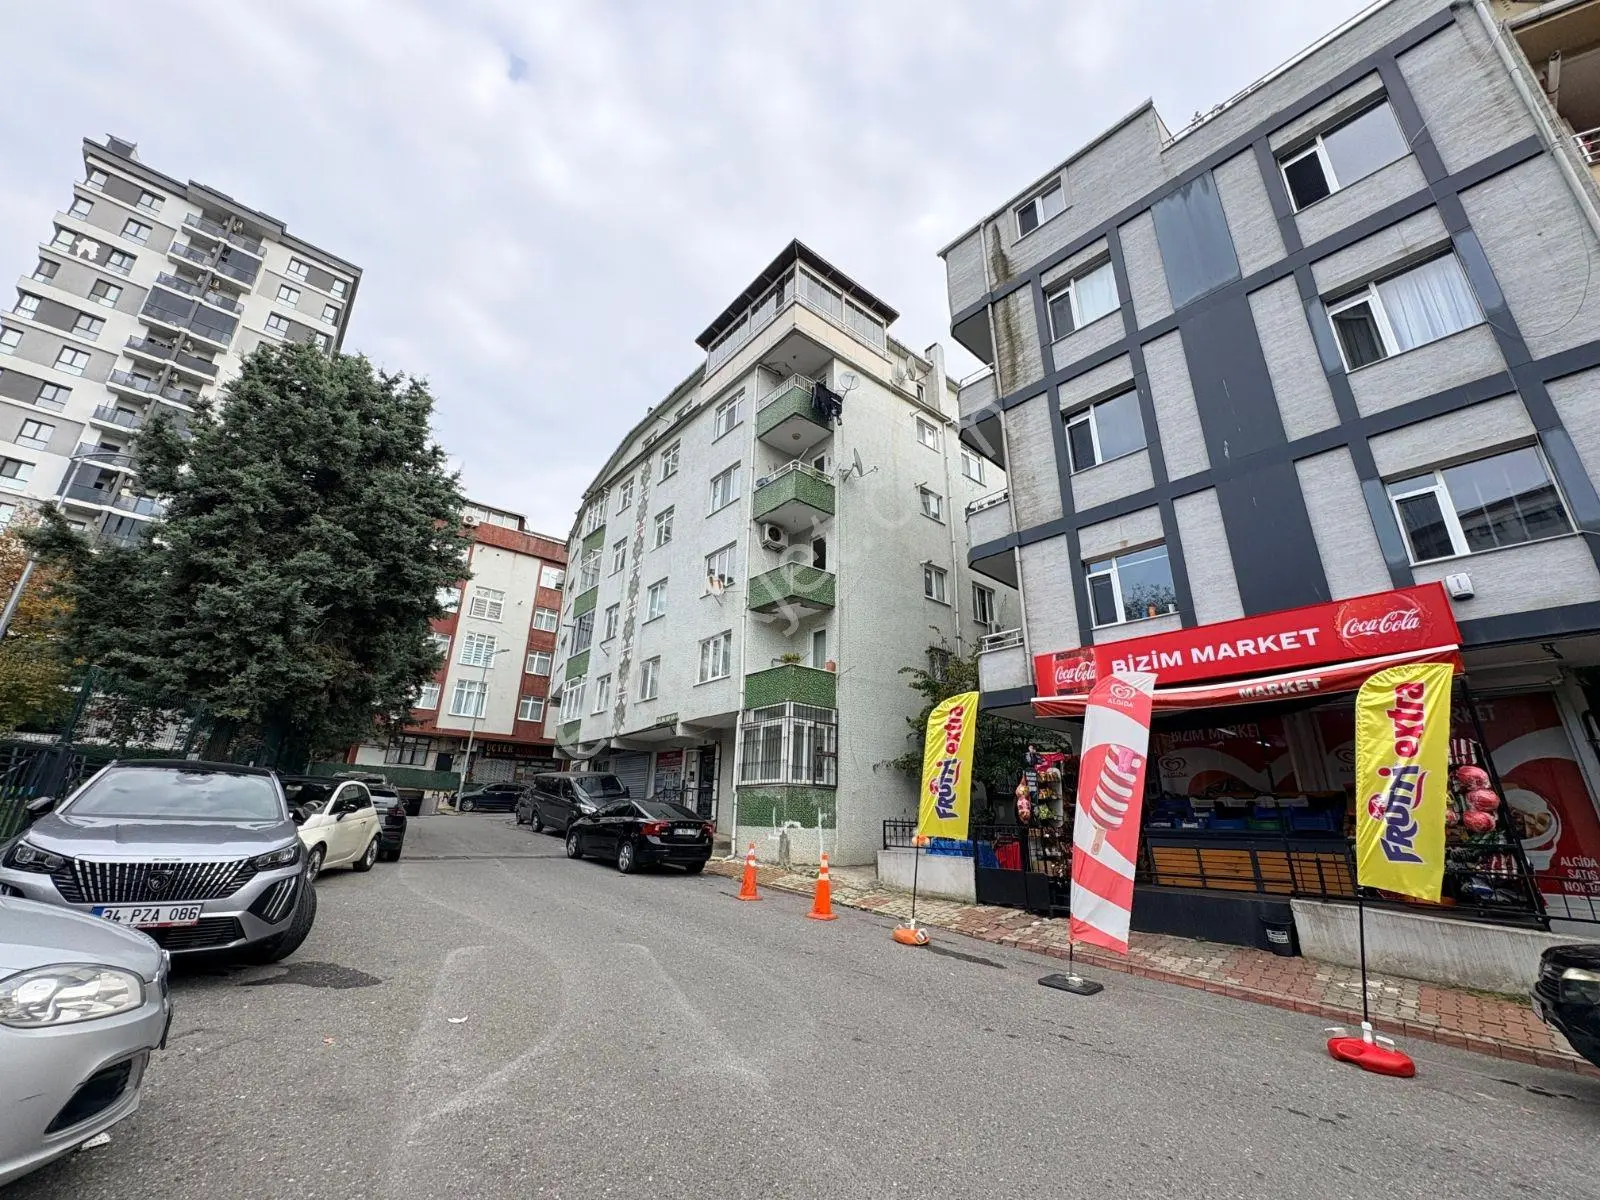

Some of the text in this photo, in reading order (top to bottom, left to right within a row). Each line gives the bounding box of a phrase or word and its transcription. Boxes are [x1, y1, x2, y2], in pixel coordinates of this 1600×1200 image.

[1342, 607, 1421, 639] Coca-Cola
[1111, 627, 1320, 675] BİZİM MARKET
[1055, 660, 1097, 685] Coca-Cola
[1238, 677, 1321, 699] MARKET
[1107, 698, 1134, 709] ALGIDA
[1451, 704, 1495, 723] RKET
[943, 705, 964, 755] extra
[1386, 682, 1425, 759] extra
[130, 908, 161, 922] PZA
[169, 906, 198, 920] 086
